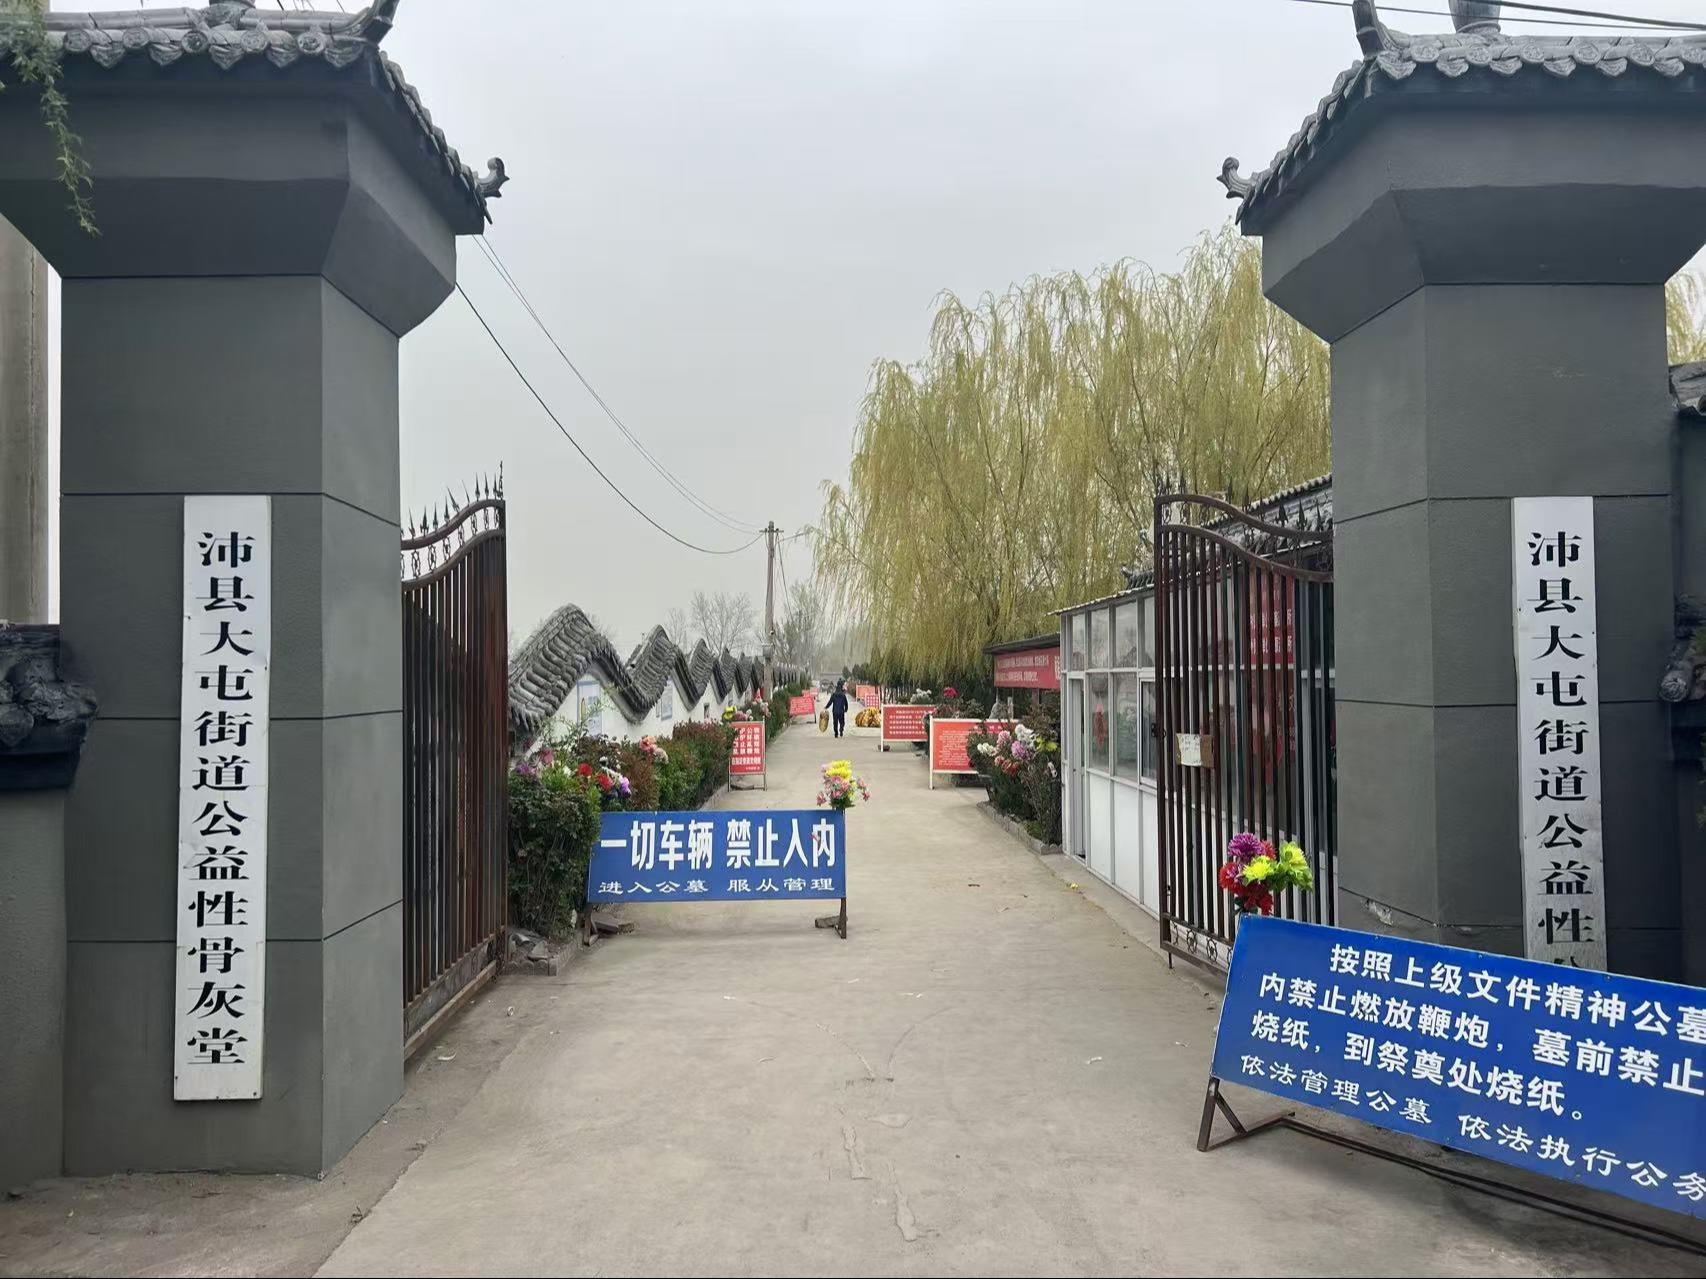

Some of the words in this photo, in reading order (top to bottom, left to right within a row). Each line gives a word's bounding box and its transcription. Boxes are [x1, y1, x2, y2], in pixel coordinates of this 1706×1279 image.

[187, 530, 255, 1065] 沛县大屯街道公益性骨灰堂
[1526, 531, 1595, 967] 沛县大屯街道公益性
[598, 879, 709, 895] 进入公墓
[726, 878, 836, 893] 服从管理
[600, 819, 714, 871] 一切车辆
[726, 818, 836, 868] 禁止入内
[1330, 943, 1706, 1045] 按照上级文件精神公墓
[1251, 1010, 1585, 1122] 烧纸，到祭奠处烧纸。
[1241, 1054, 1433, 1125] 依法管理公墓
[1457, 1113, 1706, 1202] 依法执行公务
